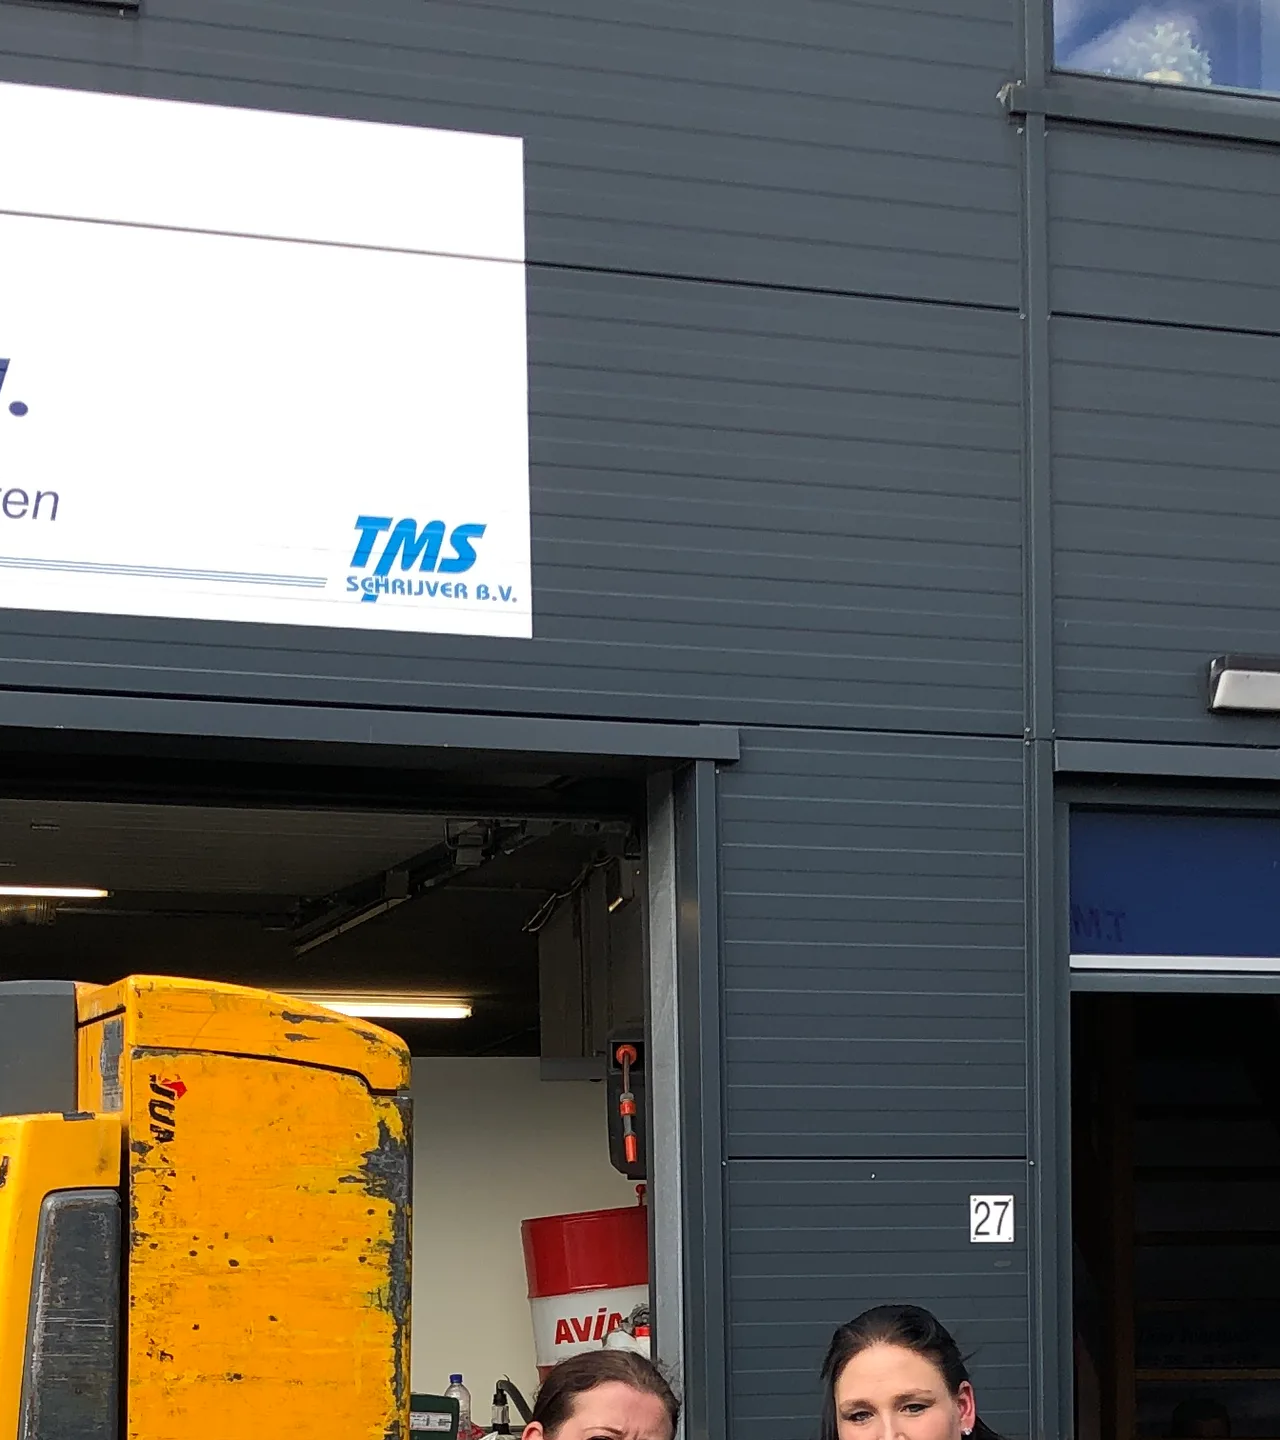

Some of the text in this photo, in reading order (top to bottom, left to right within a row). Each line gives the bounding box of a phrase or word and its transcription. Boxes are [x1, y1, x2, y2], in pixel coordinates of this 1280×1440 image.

[350, 515, 487, 577] TMS
[346, 575, 517, 603] SCHRIJVER B.V.
[974, 1201, 1009, 1235] 27
